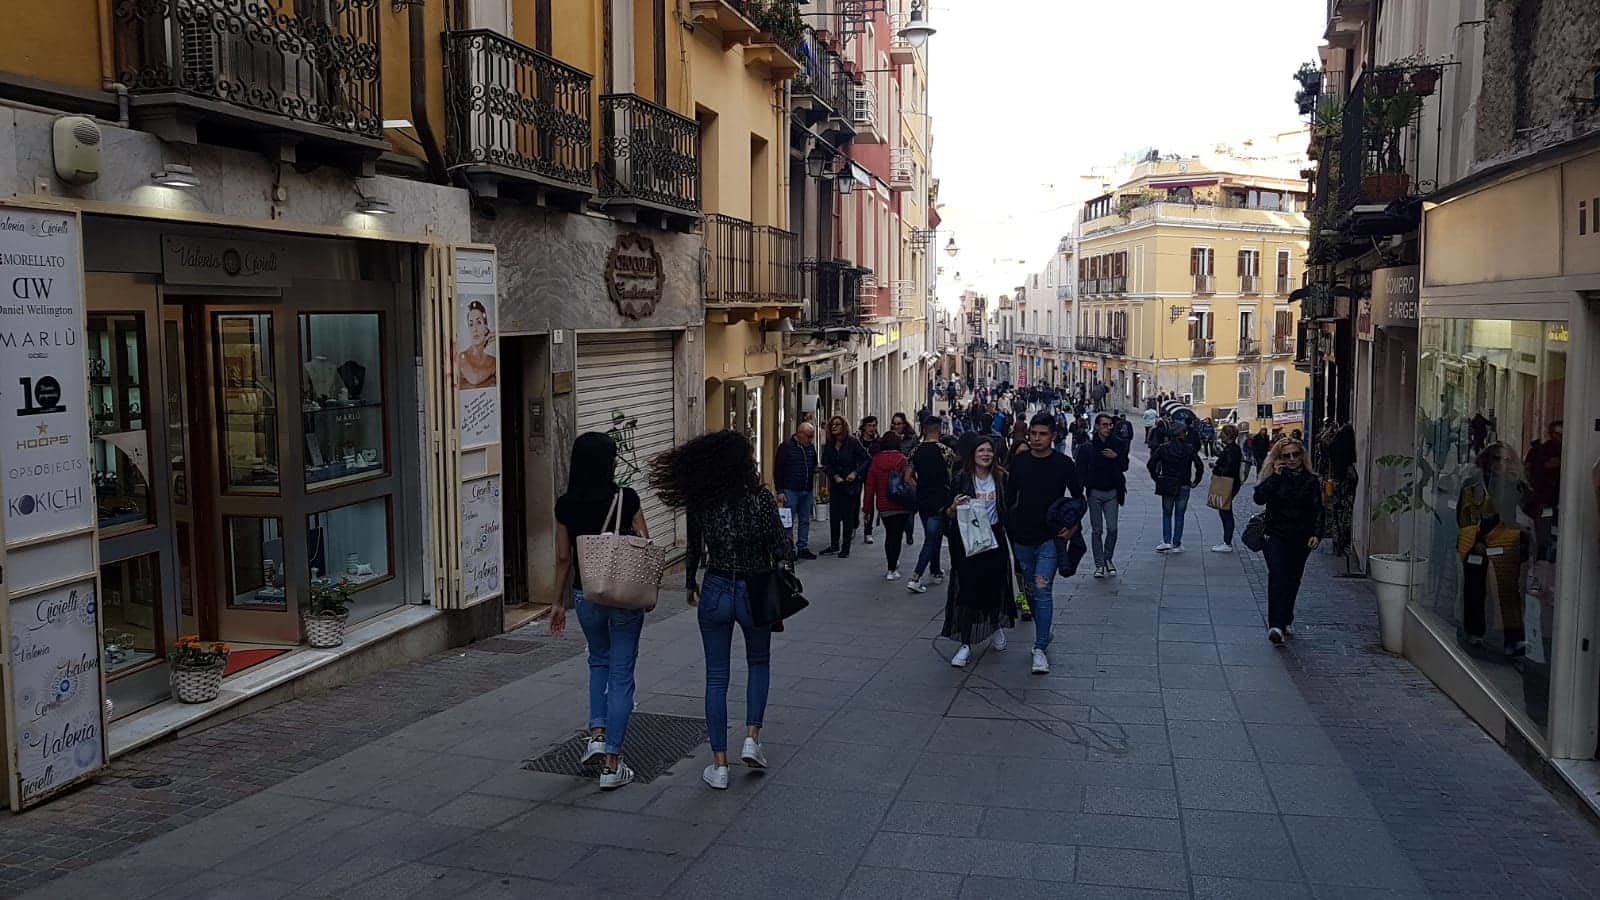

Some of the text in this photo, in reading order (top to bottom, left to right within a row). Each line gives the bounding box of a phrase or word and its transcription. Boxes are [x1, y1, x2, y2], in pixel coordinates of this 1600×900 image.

[0, 216, 25, 232] aleria
[3, 253, 65, 268] MORELLATO
[12, 277, 54, 299] DW
[1386, 276, 1415, 294] COMPRO
[26, 304, 73, 318] Wellington
[16, 434, 70, 450] HOOPS
[8, 486, 82, 518] KOKICHI
[33, 590, 79, 627] Gioielli
[30, 722, 96, 759] Valeria
